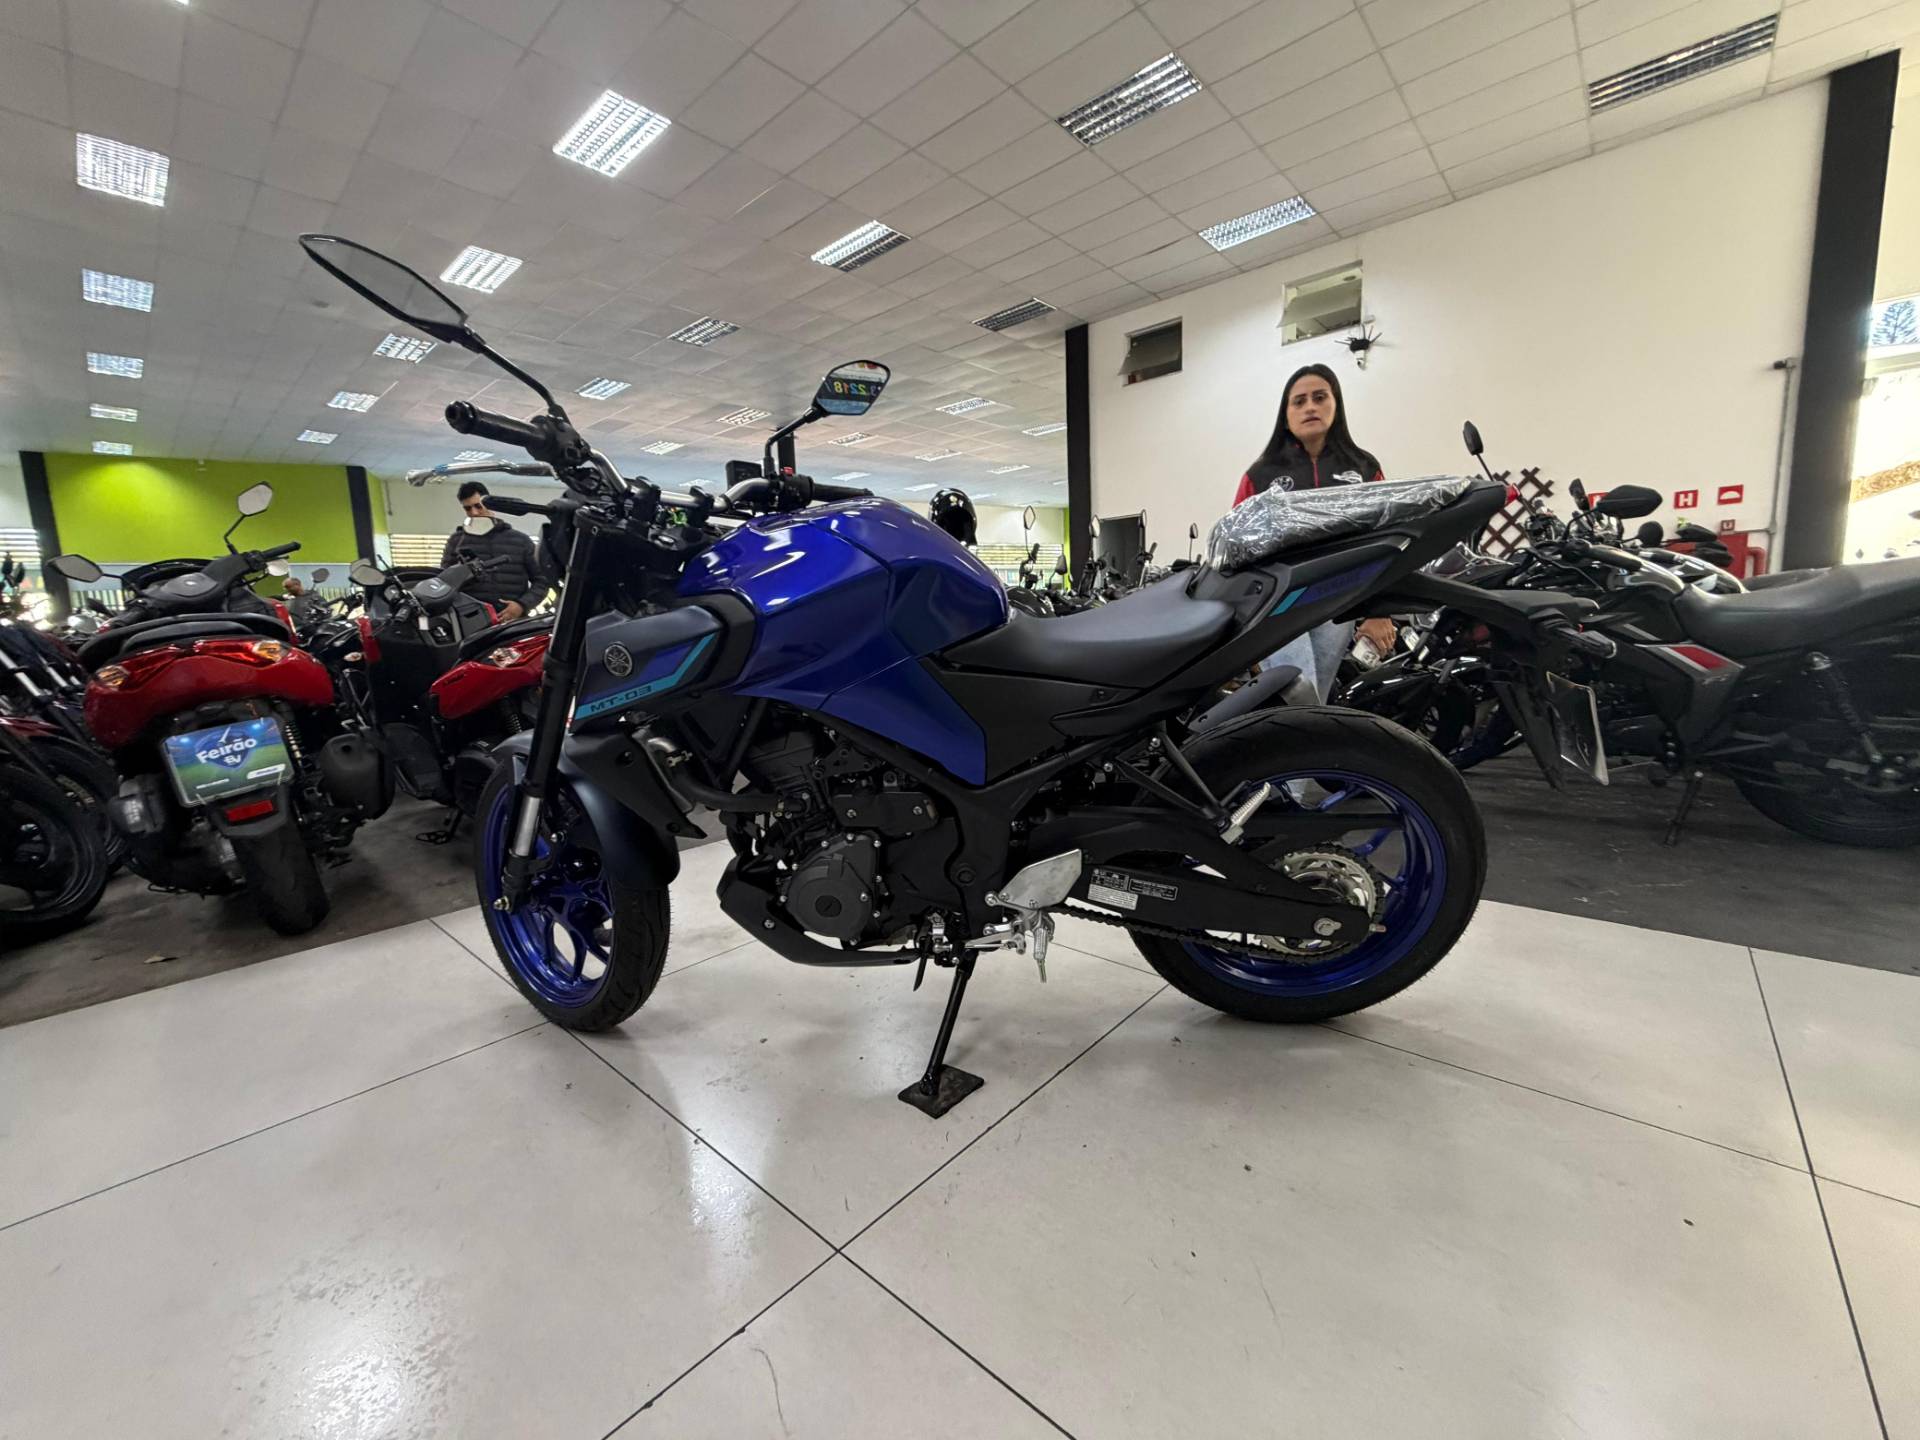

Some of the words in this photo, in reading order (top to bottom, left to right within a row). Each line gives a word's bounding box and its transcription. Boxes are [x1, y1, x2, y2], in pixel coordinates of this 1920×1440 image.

[1678, 493, 1693, 507] H
[590, 685, 652, 712] MT-03
[196, 737, 257, 764] Feirão
